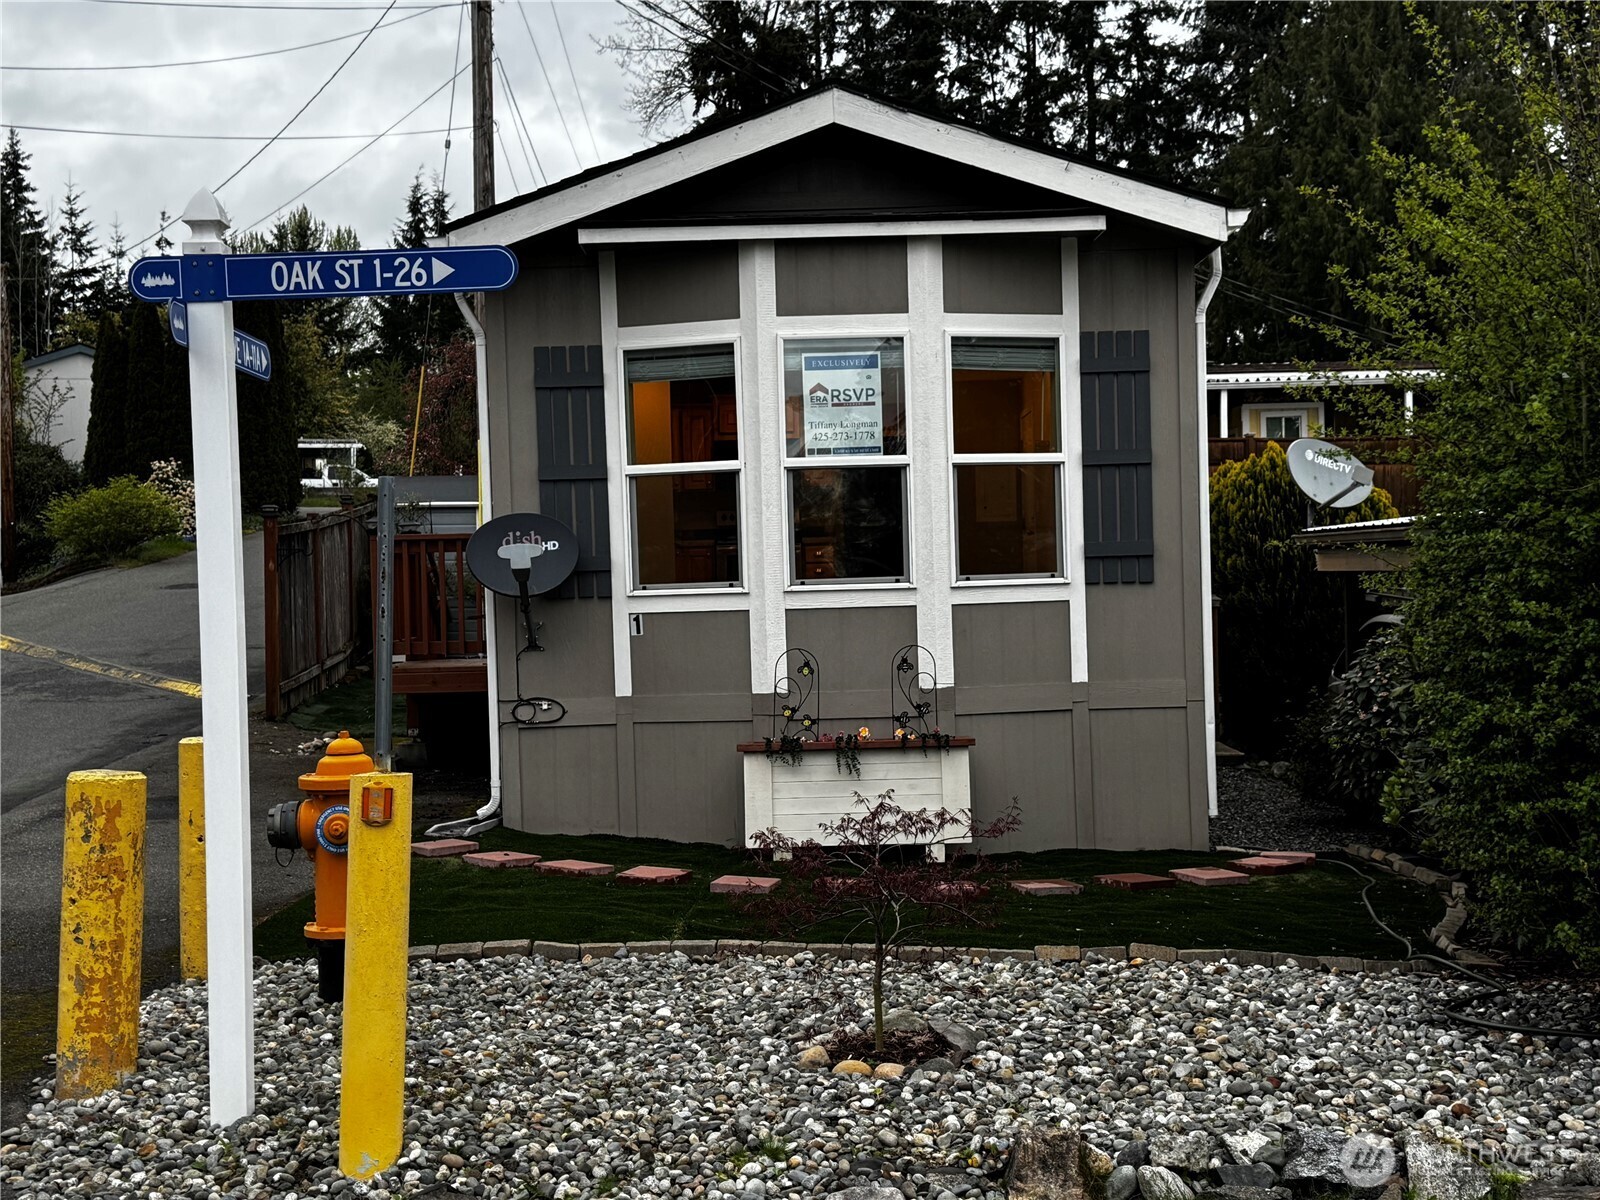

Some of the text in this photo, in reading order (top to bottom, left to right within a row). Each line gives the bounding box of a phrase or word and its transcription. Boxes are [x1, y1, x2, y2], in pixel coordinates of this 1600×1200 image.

[271, 256, 428, 291] OAK ST 1-26
[811, 357, 871, 368] EXCLUSIVELY
[831, 388, 875, 402] RSVP
[808, 420, 878, 431] Tiffany Longman
[812, 431, 876, 442] 425-273-1778
[502, 530, 559, 551] dish HD
[632, 614, 641, 635] 1
